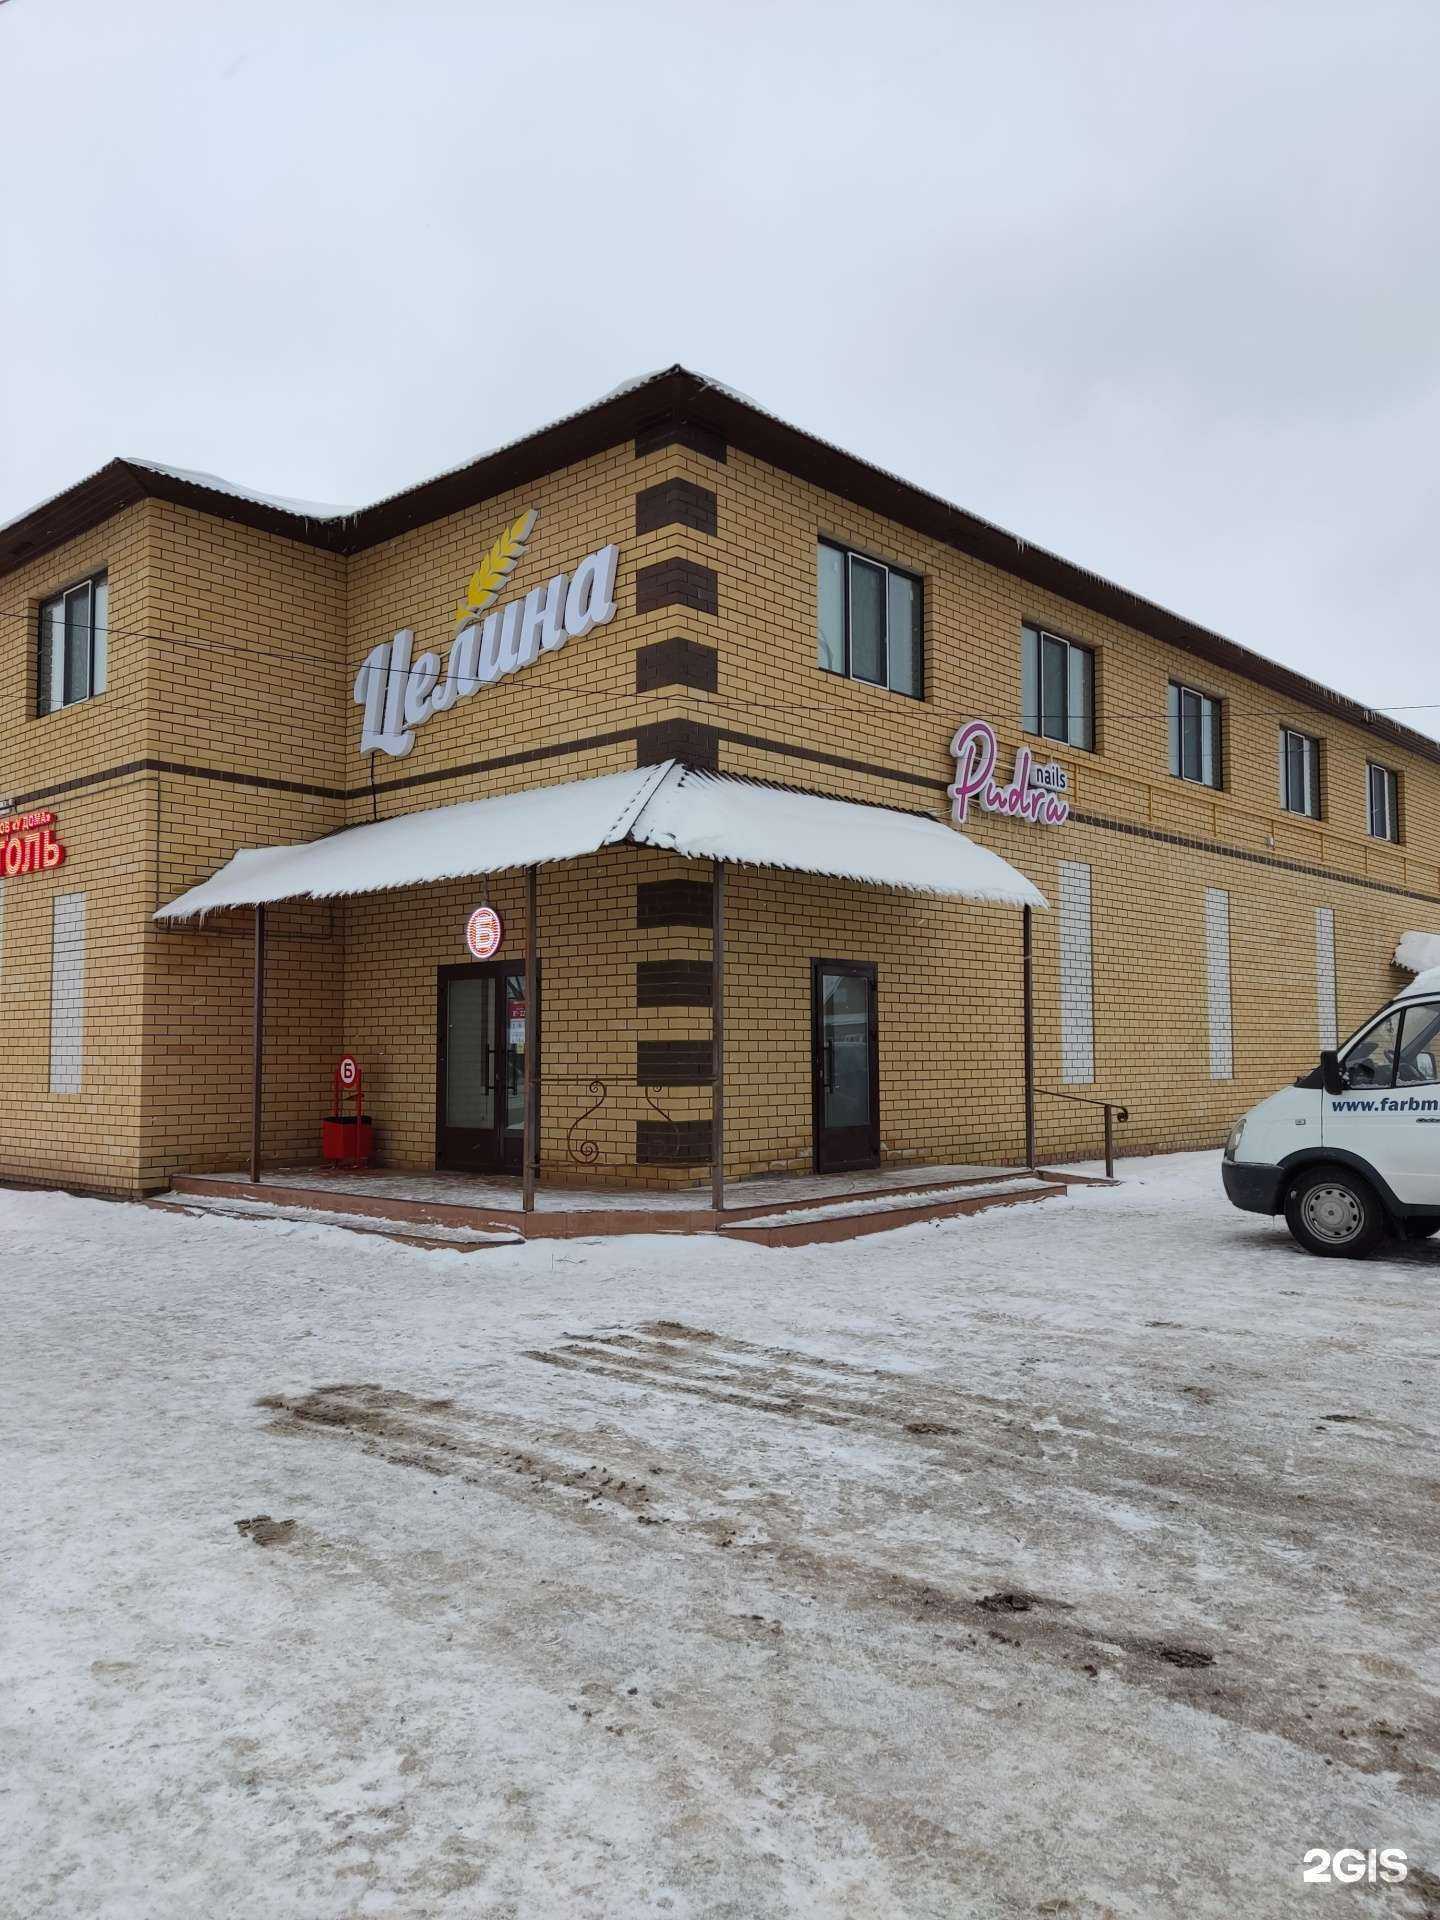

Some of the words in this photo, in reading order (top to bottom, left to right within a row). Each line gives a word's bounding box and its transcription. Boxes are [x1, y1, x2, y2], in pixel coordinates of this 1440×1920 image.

[354, 544, 620, 757] Целина
[950, 720, 1069, 824] Pudra
[1036, 766, 1066, 789] nails
[1332, 1097, 1439, 1112] www.farbm
